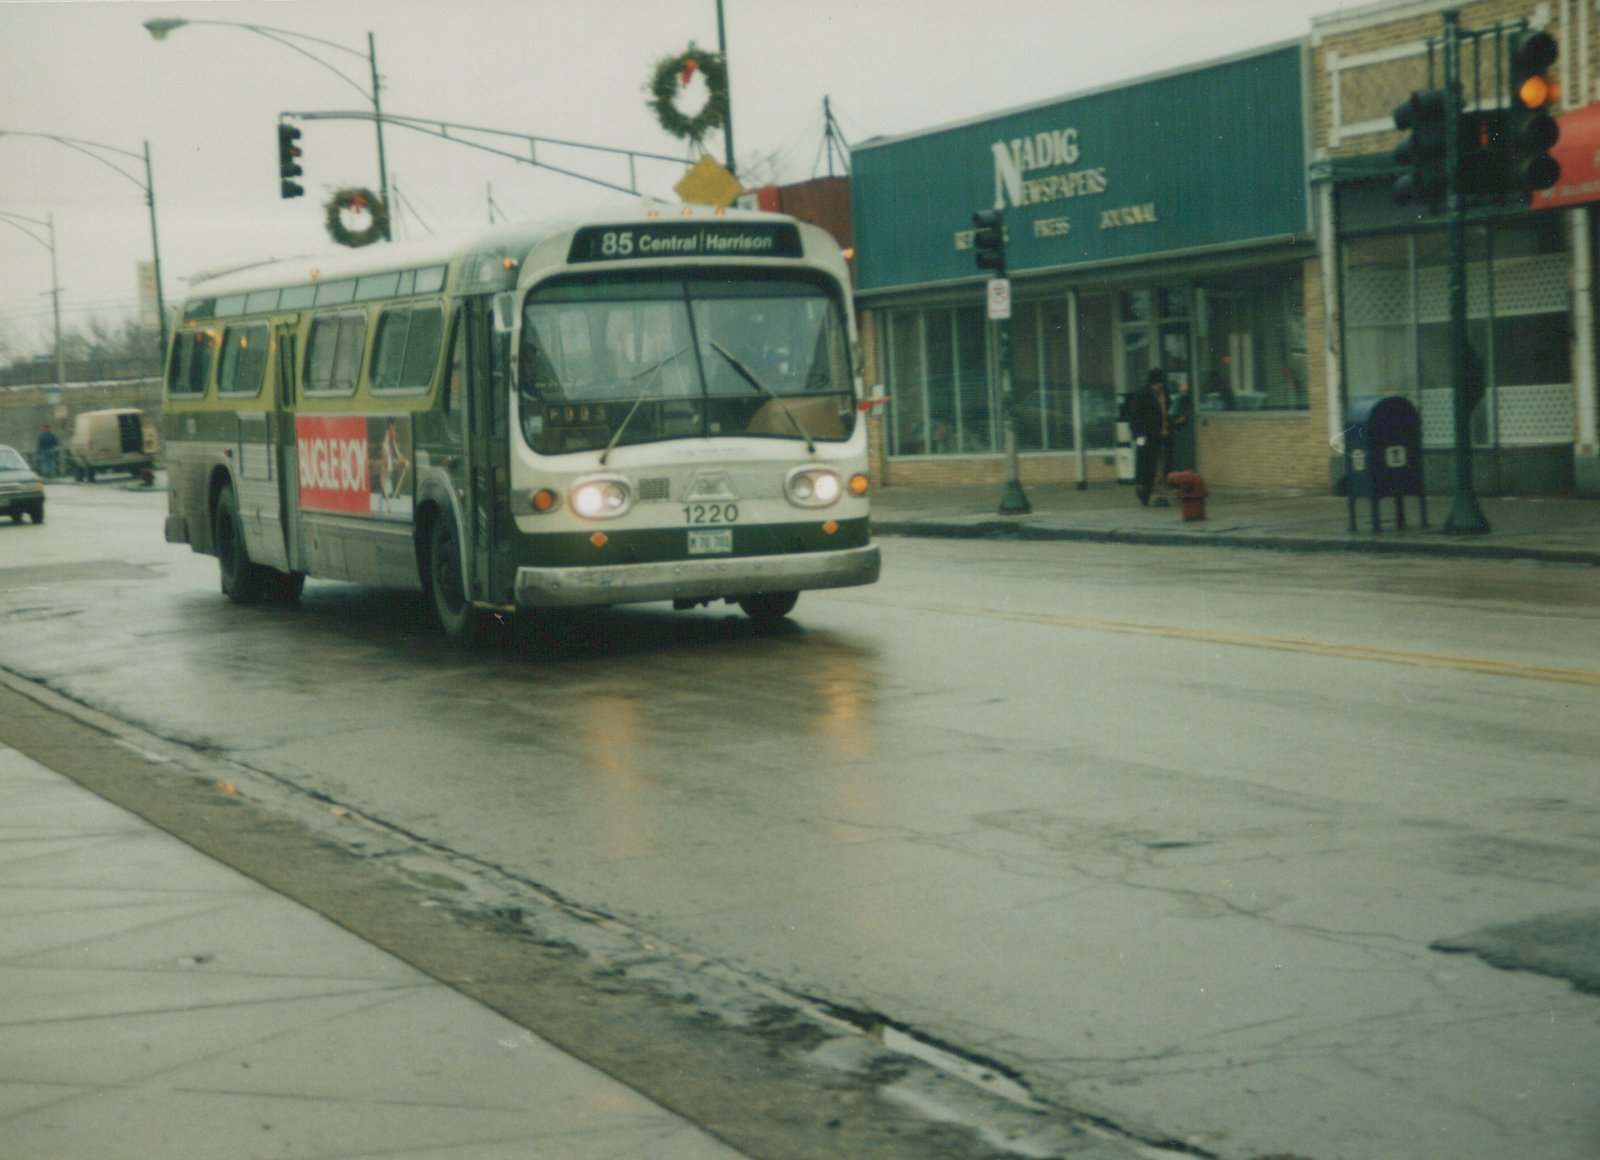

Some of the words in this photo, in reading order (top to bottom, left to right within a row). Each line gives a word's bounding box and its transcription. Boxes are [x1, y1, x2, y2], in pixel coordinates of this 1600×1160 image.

[991, 128, 1080, 208] NADIG
[602, 232, 633, 254] 85
[638, 233, 697, 251] Central
[706, 233, 772, 249] Harrison
[299, 438, 340, 490] BUGLE
[341, 438, 367, 493] BOY
[683, 503, 739, 523] 1220
